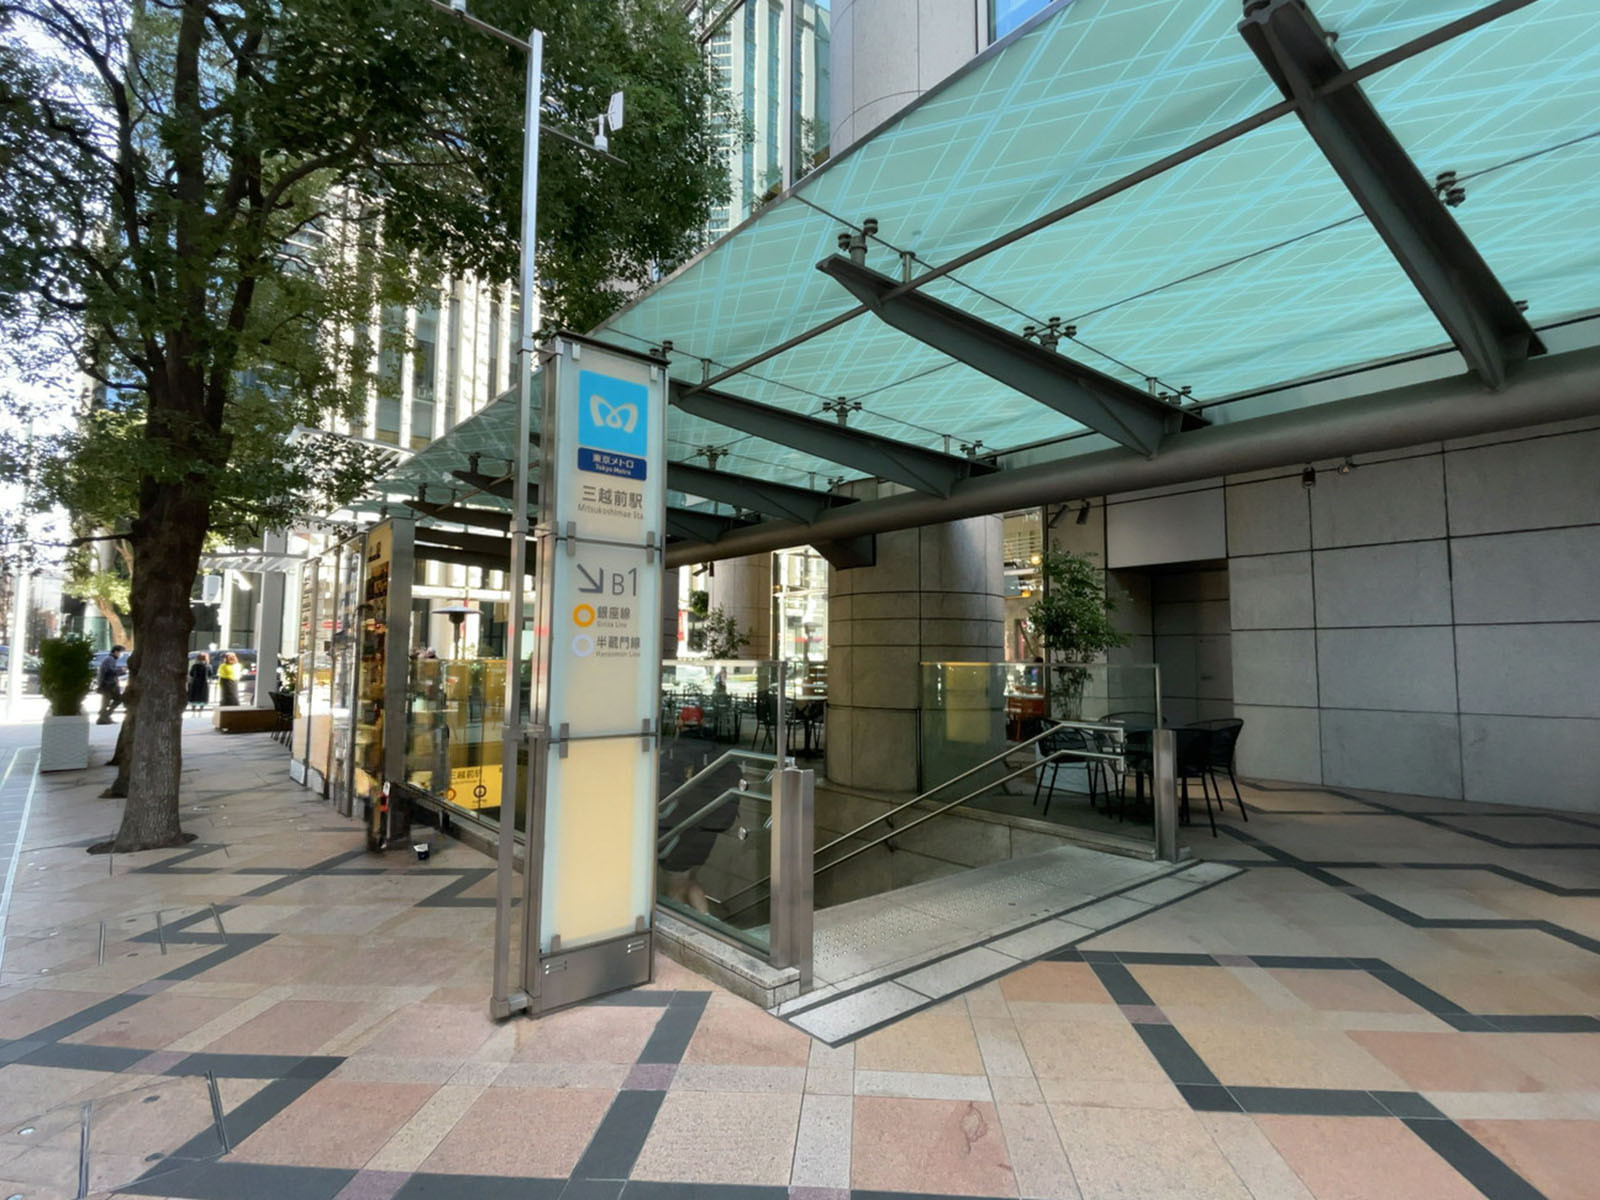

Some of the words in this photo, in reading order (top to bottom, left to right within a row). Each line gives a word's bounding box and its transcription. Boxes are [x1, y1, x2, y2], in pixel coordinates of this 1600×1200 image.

[592, 453, 634, 469] 東京メトロ
[582, 485, 643, 509] 三越前駅
[612, 567, 637, 597] B1
[597, 606, 631, 620] 銀座線
[597, 635, 641, 650] 半蔵門線
